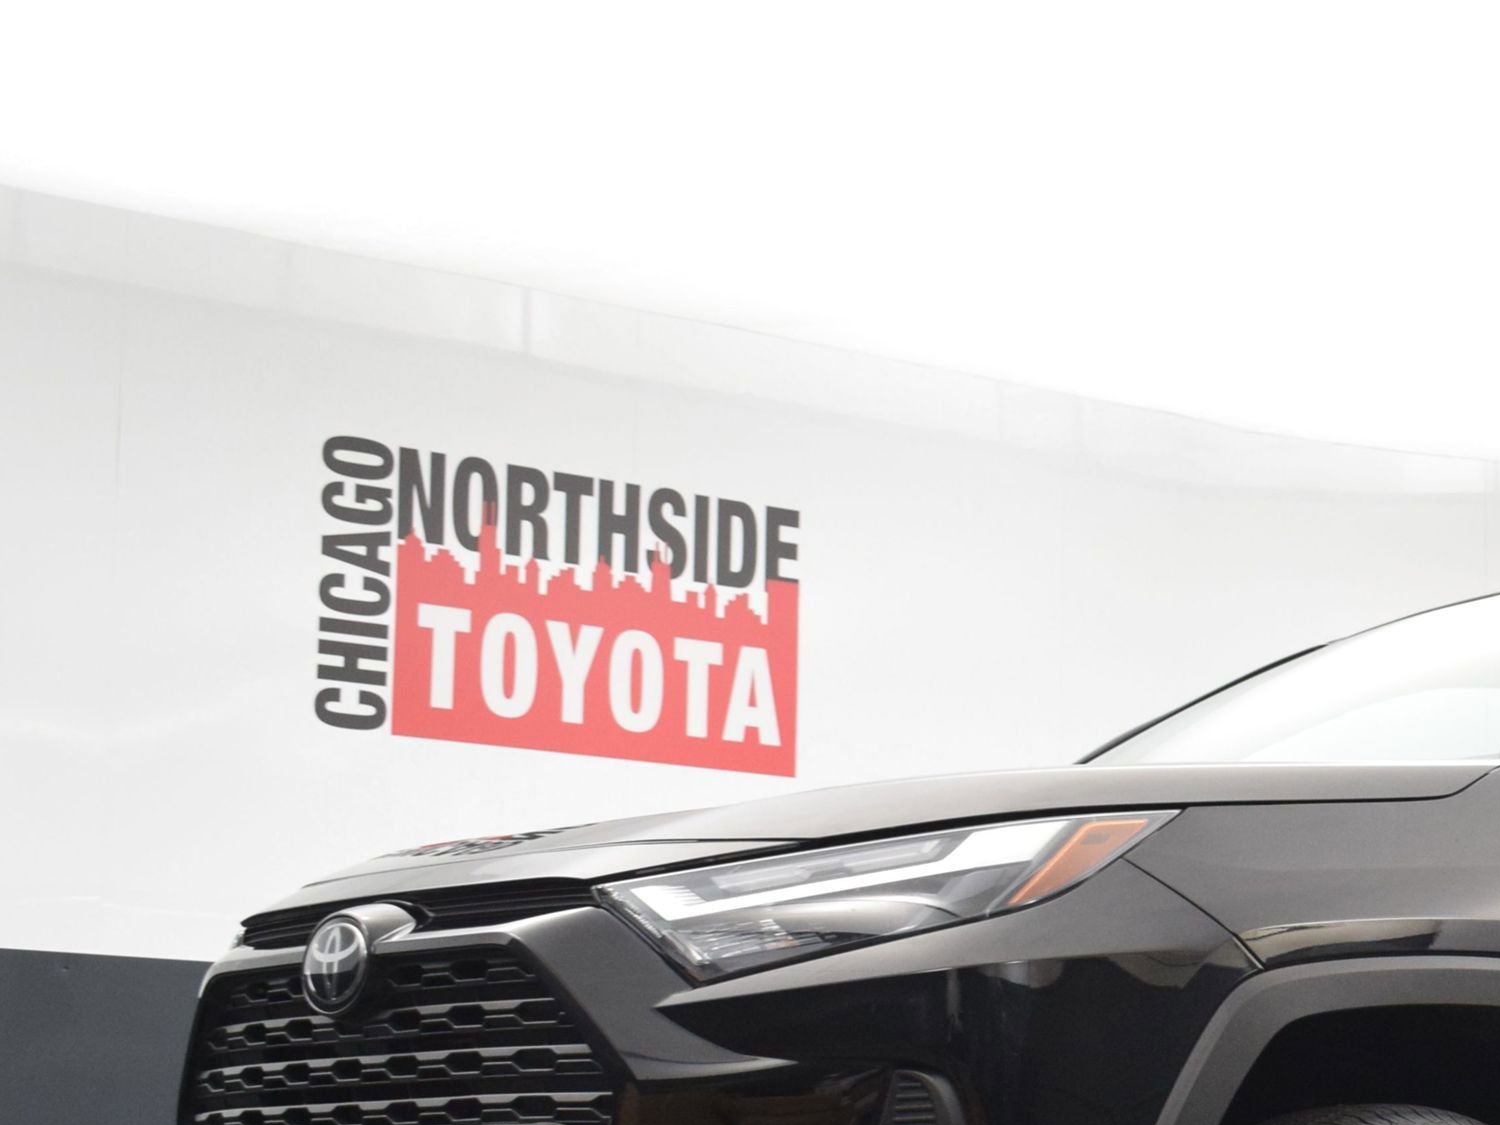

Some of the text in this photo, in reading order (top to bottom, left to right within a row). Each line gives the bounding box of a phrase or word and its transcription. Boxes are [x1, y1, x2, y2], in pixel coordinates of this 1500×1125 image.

[314, 435, 395, 731] CHICAGO
[398, 445, 801, 590] NORTHSIDE
[416, 602, 782, 748] TOYOTA
